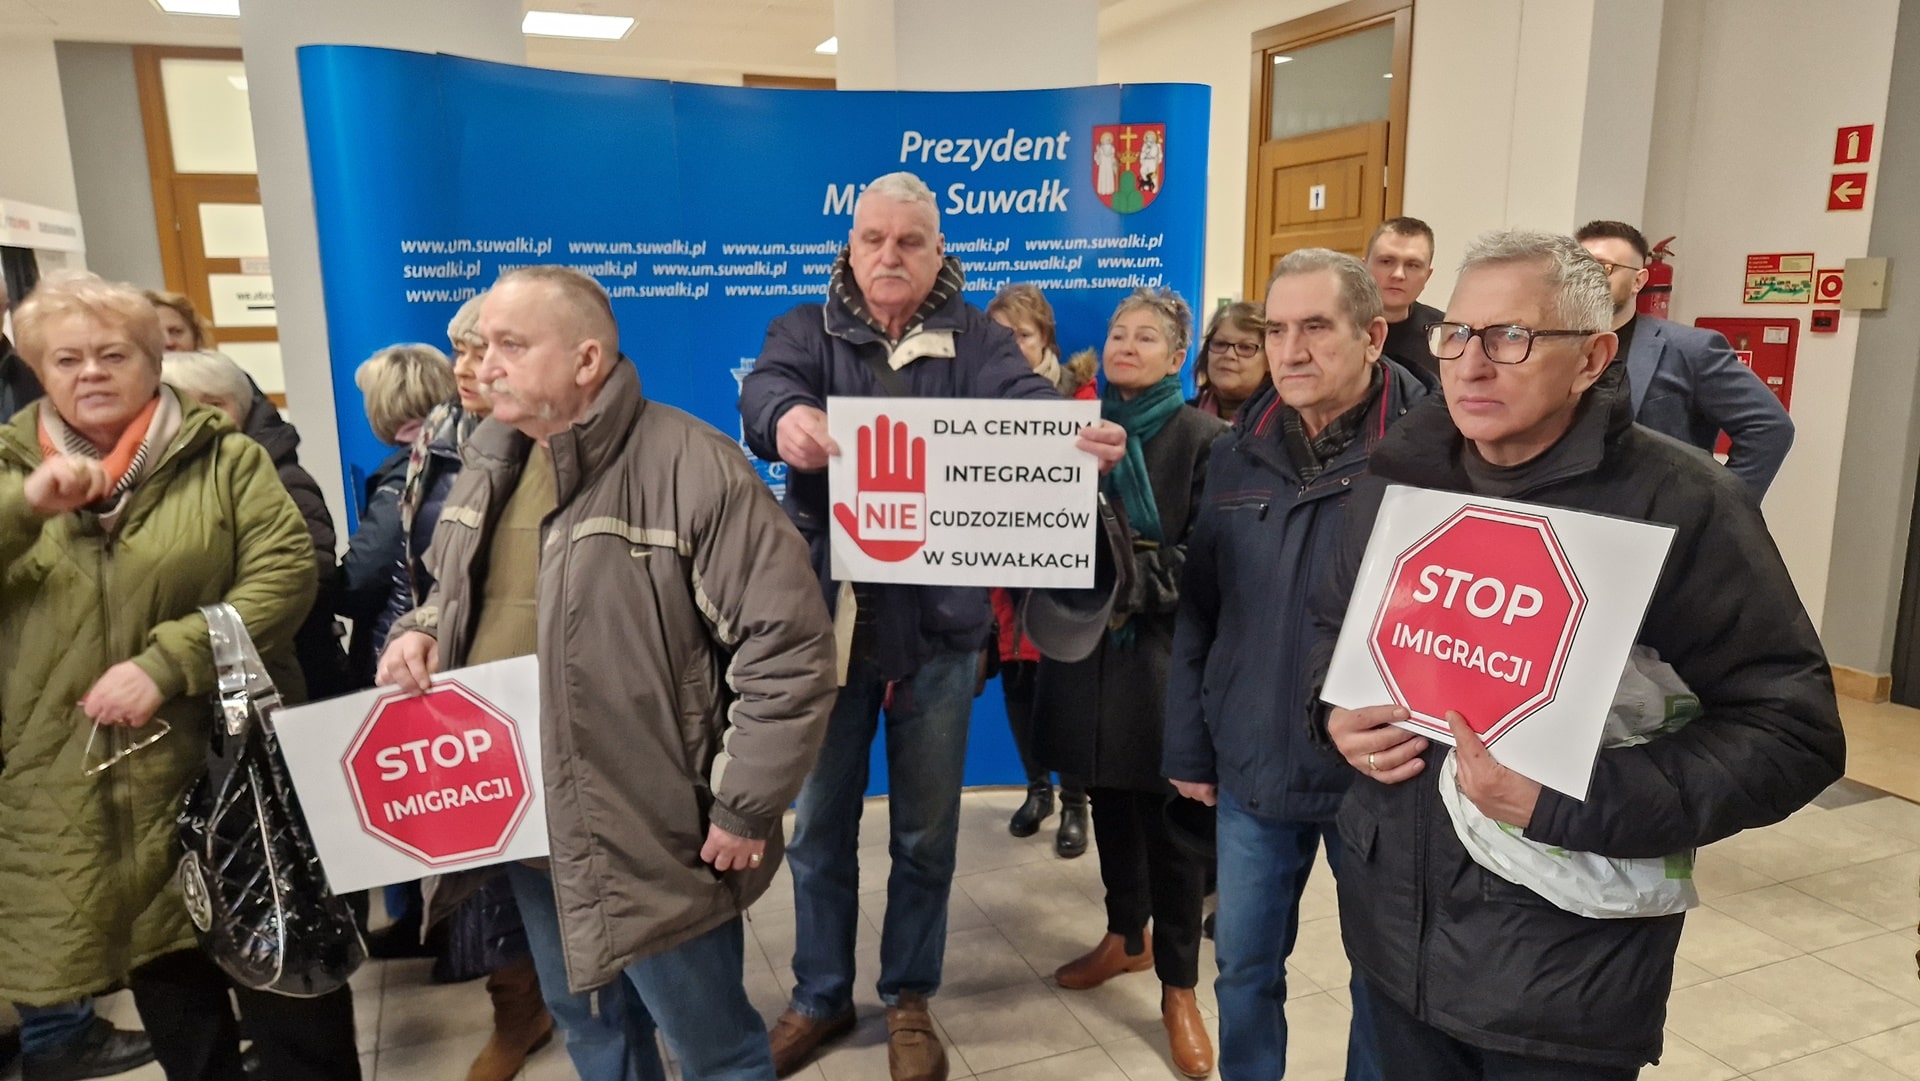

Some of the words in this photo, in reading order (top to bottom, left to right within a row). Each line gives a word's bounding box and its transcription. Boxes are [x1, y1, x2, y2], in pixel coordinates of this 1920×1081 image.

[900, 128, 1071, 171] Prezydent
[945, 179, 1069, 215] Suwałk
[401, 237, 552, 256] www.um.suwalki.pl
[569, 239, 706, 258] www.um.suwalki.pl
[722, 240, 842, 255] www.um.suwalki
[1025, 233, 1163, 251] www.um.suwalki.pl
[404, 260, 480, 280] suwalki.pl
[653, 260, 787, 278] www.um.suwalki.pl
[1097, 256, 1163, 268] www.um.
[934, 419, 976, 436] DLA
[945, 466, 1081, 483] INTEGRACJI
[865, 503, 917, 530] NIE
[930, 508, 1090, 529] CUDZOZIEMCÓW
[923, 551, 944, 566] W
[951, 551, 1089, 568] SUWAŁKACH
[1412, 565, 1544, 626] STOP
[1391, 622, 1532, 687] IMIGRACJI
[375, 728, 493, 782] STOP
[383, 777, 513, 823] IMIGRACJI
